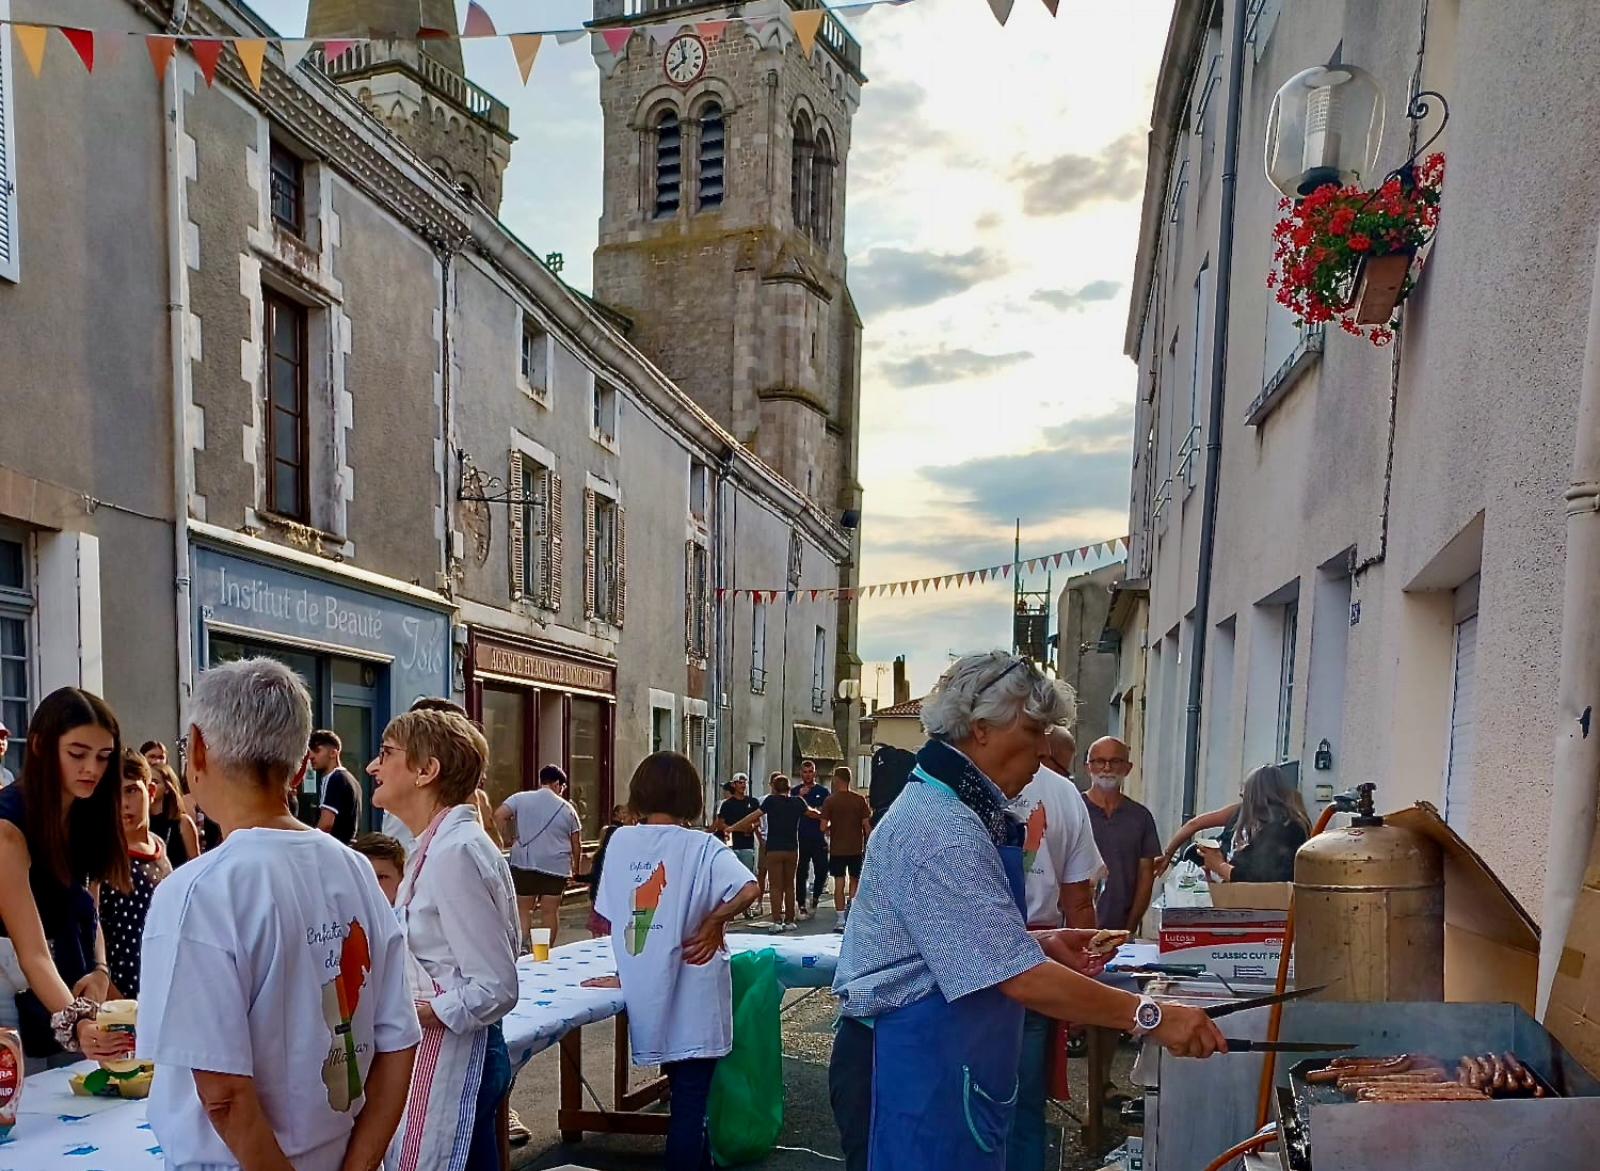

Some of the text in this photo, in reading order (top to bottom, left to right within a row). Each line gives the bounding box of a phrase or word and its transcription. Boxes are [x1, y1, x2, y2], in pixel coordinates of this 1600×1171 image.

[220, 567, 382, 639] Institut de Beauté
[491, 649, 522, 673] AGENCE
[524, 656, 564, 682] HYACINTHE
[1164, 933, 1196, 943] Lutosa
[1211, 951, 1248, 960] CLASSIC
[1249, 951, 1267, 960] CUT
